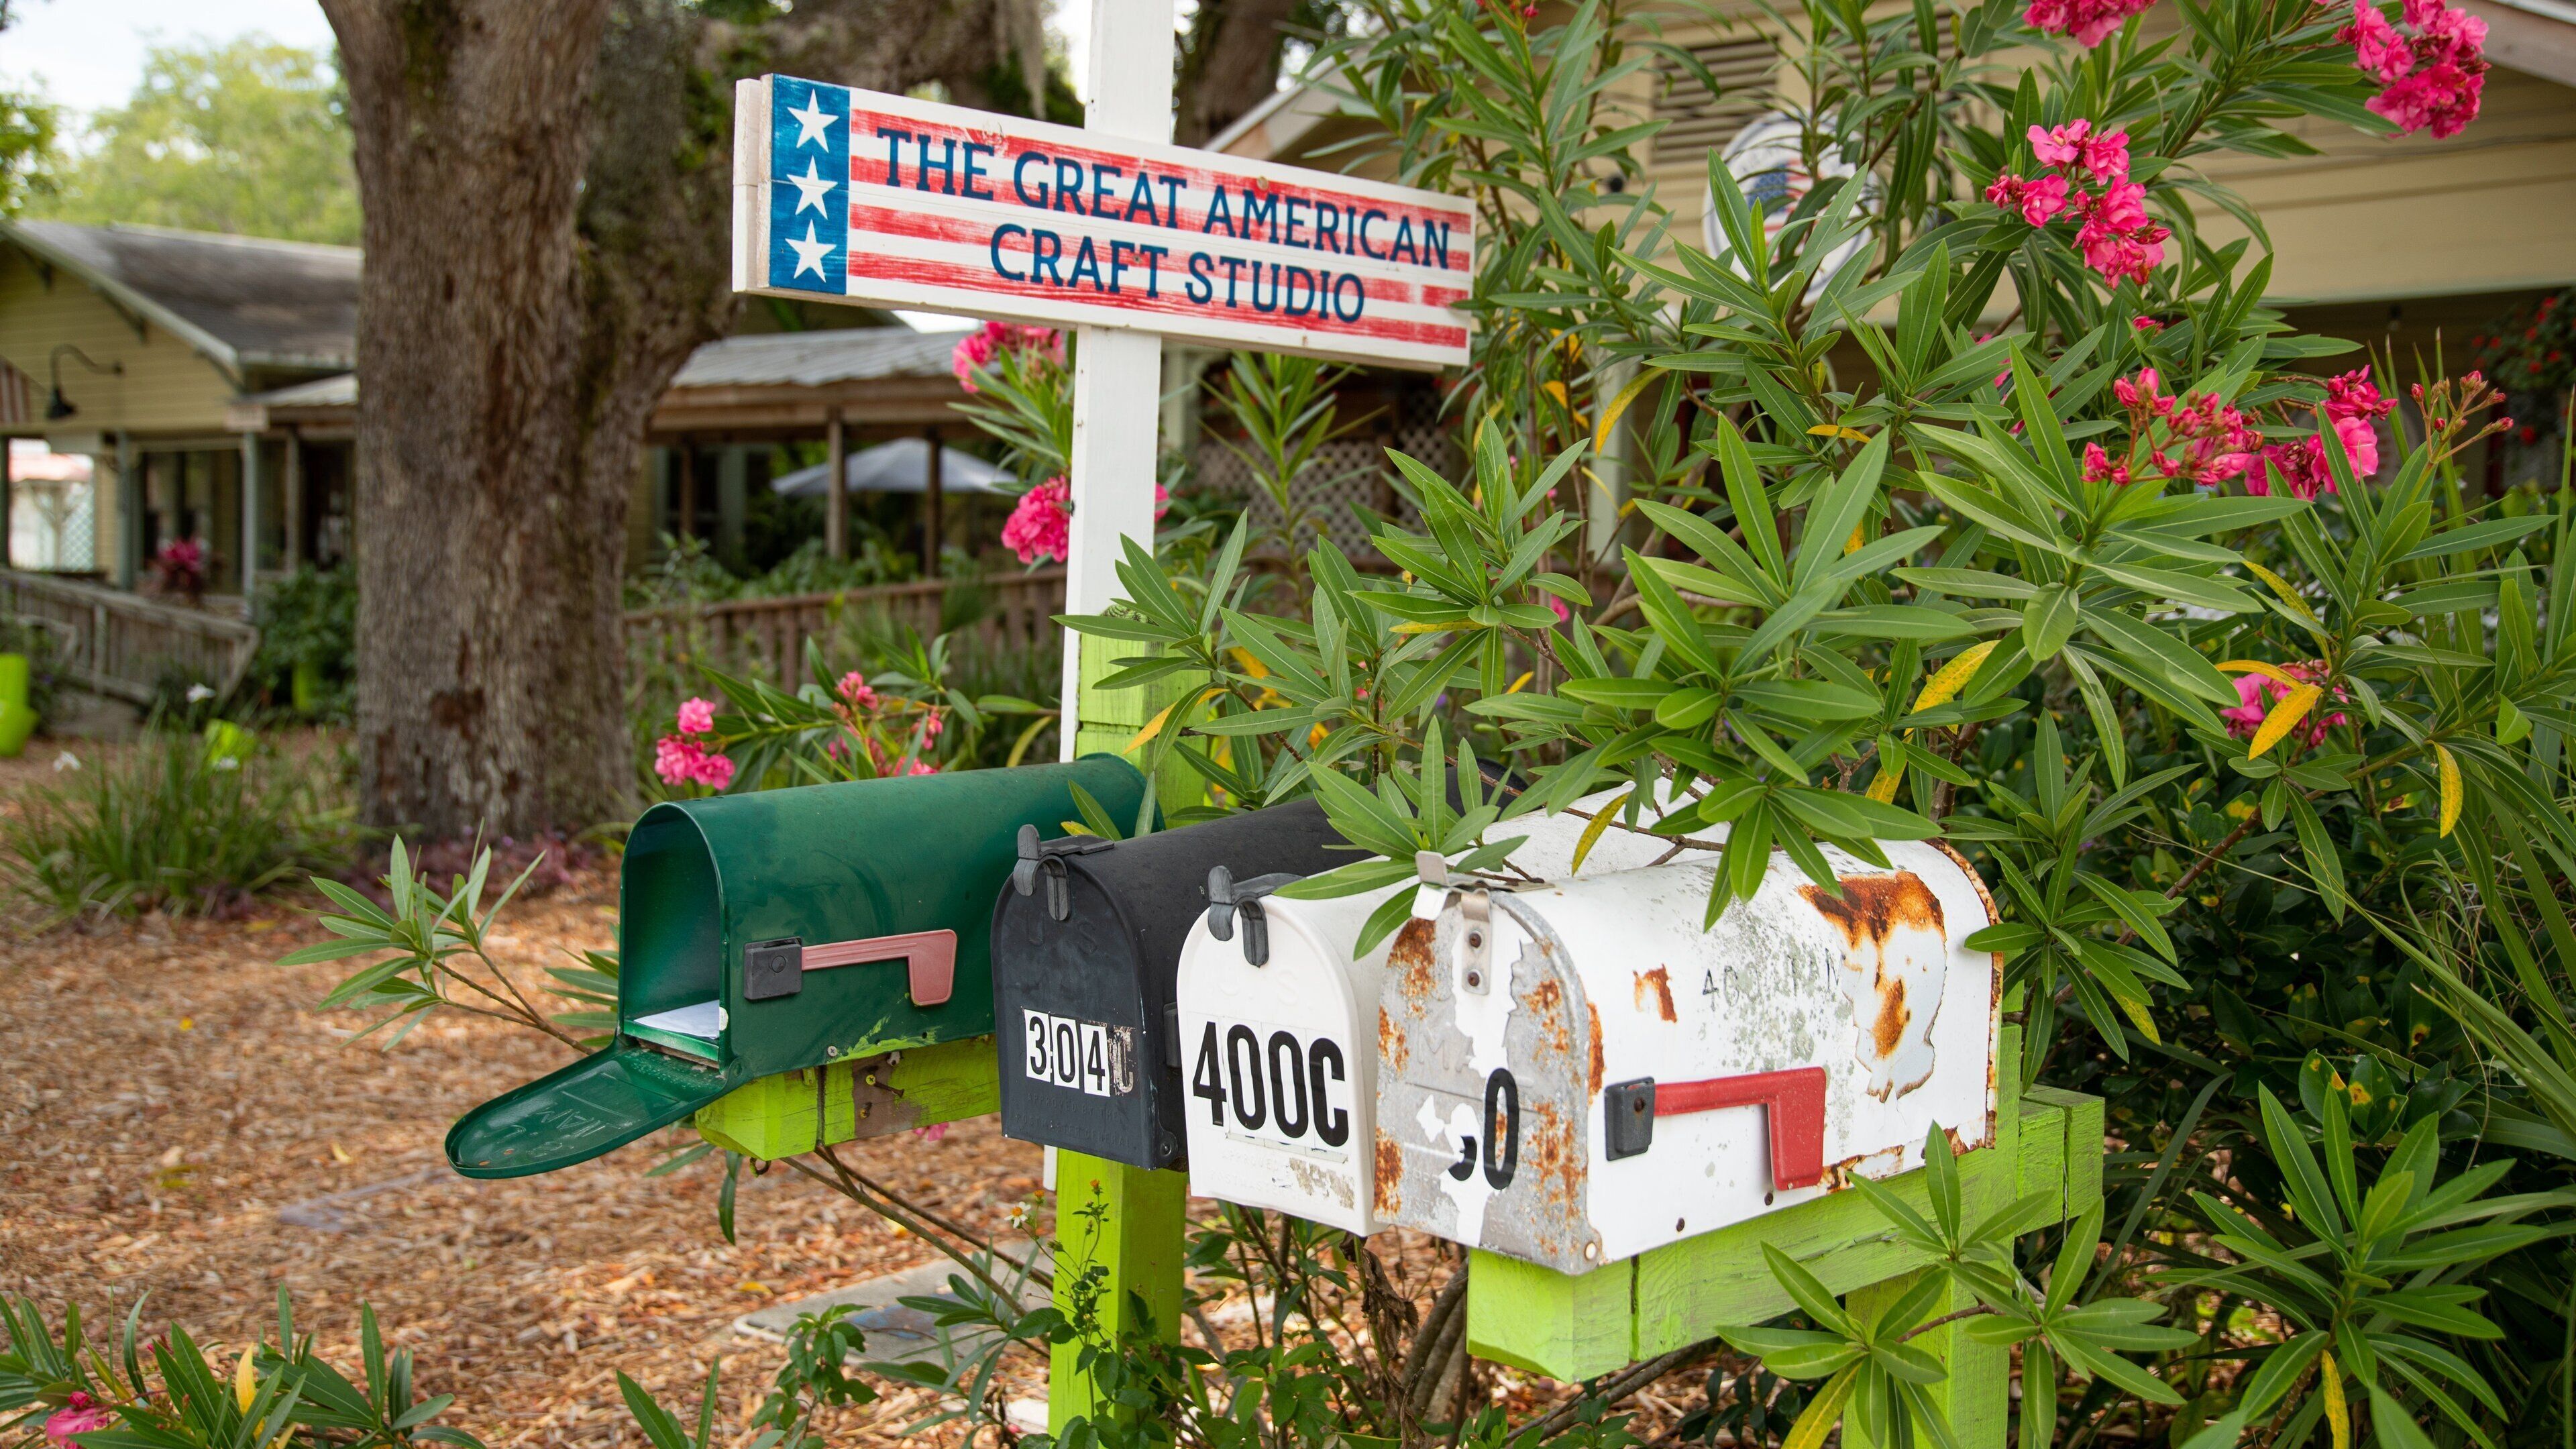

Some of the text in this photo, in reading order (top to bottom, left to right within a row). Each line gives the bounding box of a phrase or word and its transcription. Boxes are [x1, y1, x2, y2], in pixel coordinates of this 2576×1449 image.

[877, 127, 1450, 270] THE GREAT AMERICAN
[990, 223, 1365, 323] CRAFT STUDIO
[1192, 1020, 1349, 1147] 400C
